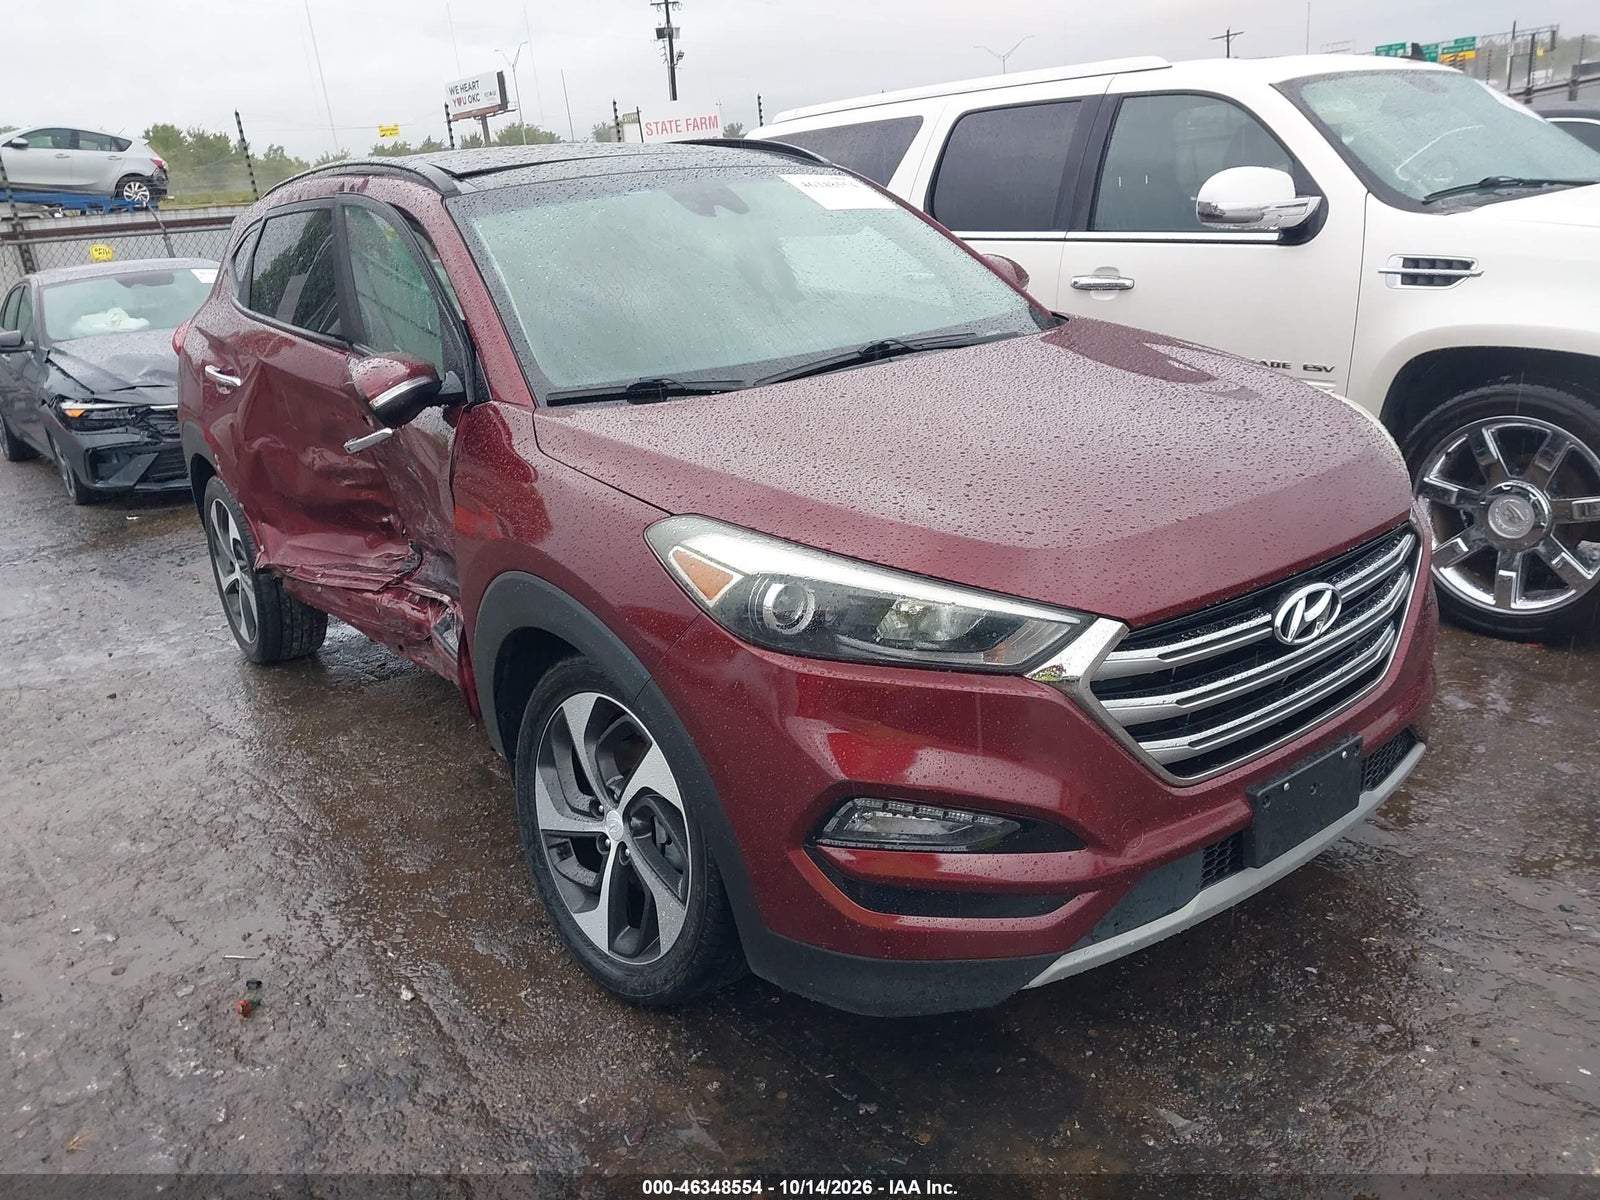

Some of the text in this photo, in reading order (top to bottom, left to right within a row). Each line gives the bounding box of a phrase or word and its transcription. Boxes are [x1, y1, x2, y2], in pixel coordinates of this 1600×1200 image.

[449, 80, 480, 96] WE HEART
[467, 93, 480, 104] OKC
[645, 115, 719, 137] STATE FARM
[1302, 364, 1335, 373] ESV
